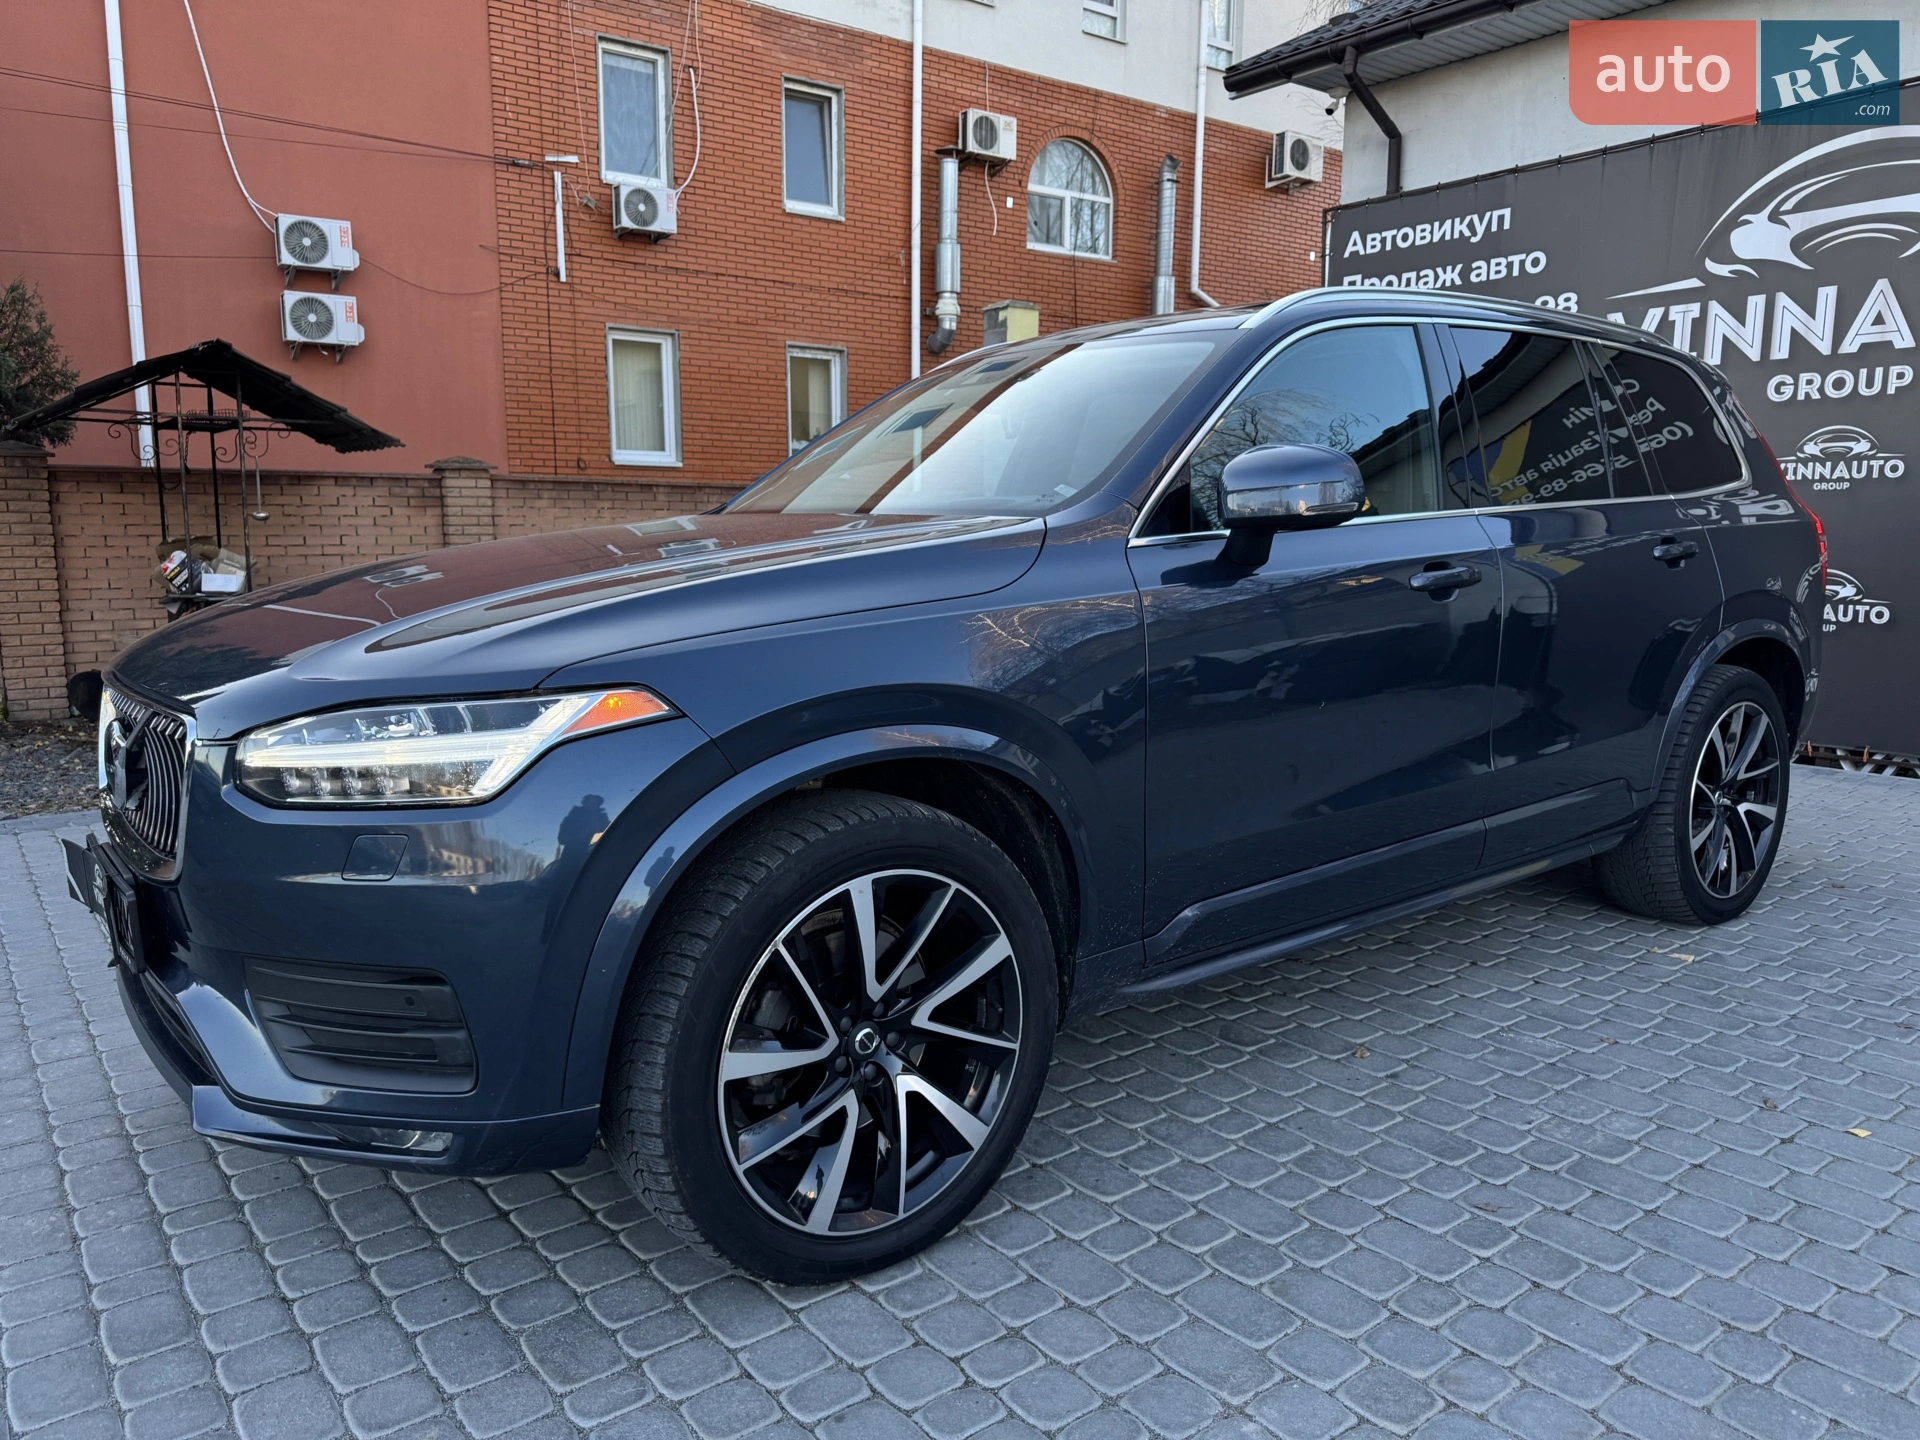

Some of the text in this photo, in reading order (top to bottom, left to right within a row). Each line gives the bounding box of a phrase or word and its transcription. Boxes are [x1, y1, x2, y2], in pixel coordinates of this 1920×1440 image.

[1343, 207, 1512, 258] Автовикуп
[1470, 251, 1547, 283] авто
[1766, 365, 1914, 402] GROUP
[1780, 459, 1905, 480] INNAUTO
[1813, 482, 1850, 490] GROUP
